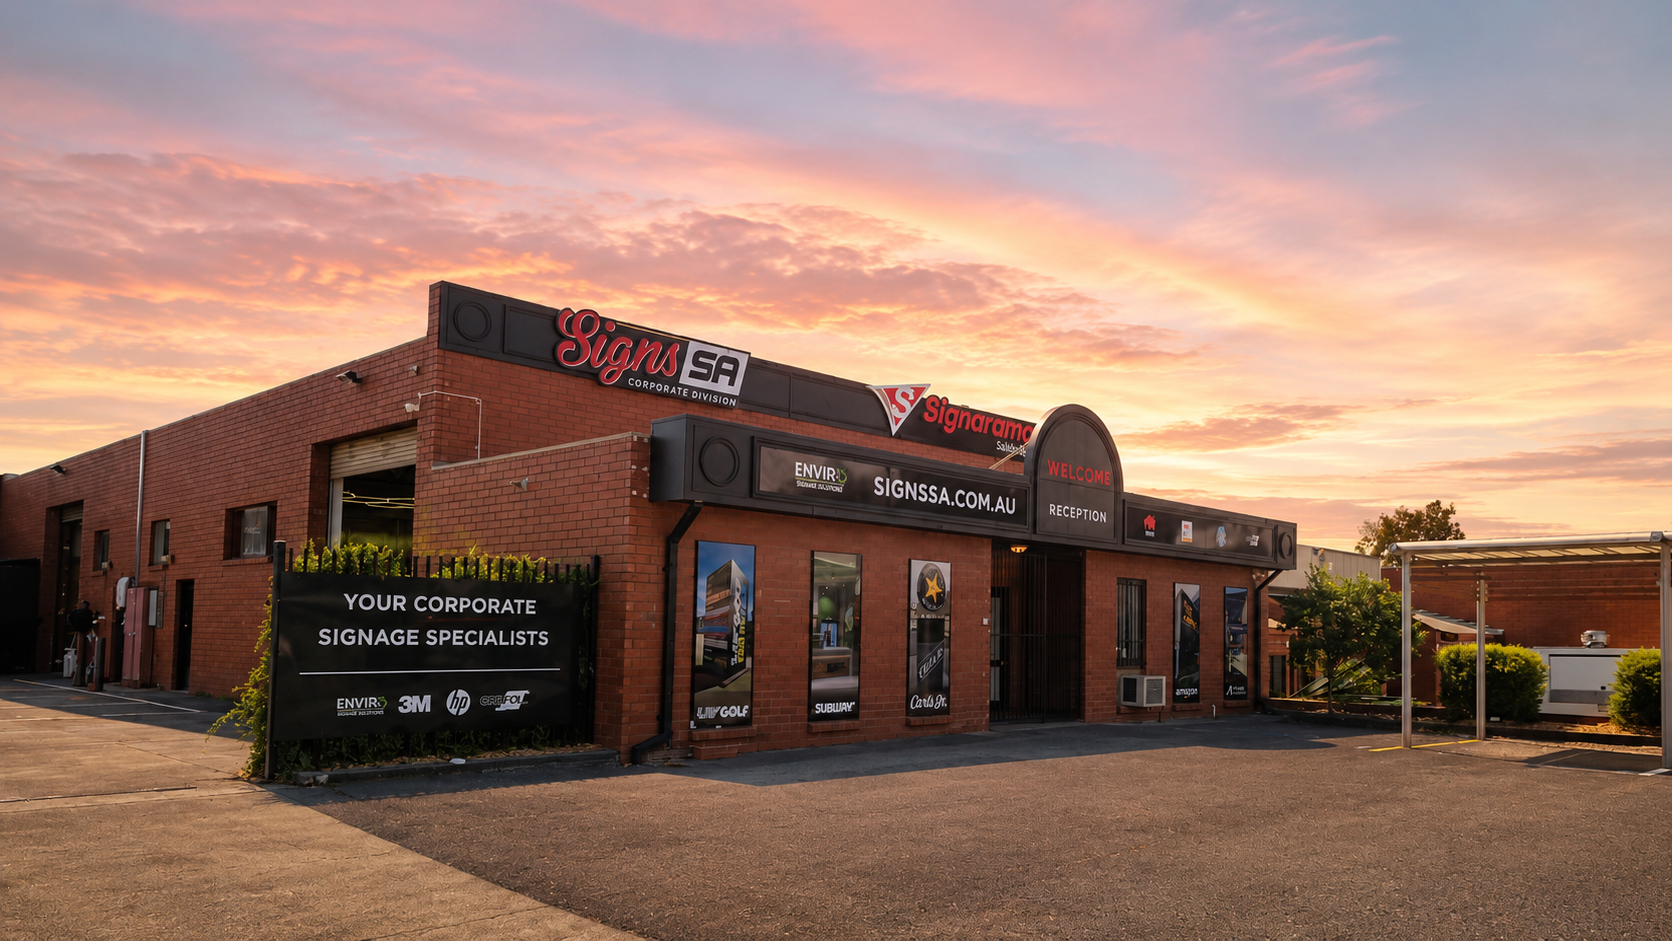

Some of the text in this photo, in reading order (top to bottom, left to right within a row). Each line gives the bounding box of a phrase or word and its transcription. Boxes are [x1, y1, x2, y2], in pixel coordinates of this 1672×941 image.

[556, 308, 741, 387] Signs SA
[628, 377, 737, 407] CORPORATE DIVISION
[1047, 459, 1111, 486] WELCOME
[873, 475, 1017, 515] SIGNSSA.COM.AU
[1049, 503, 1107, 523] RECEPTION
[343, 593, 537, 615] YOUR CORPORATE
[318, 628, 550, 647] SIGNAGE SPECIALISTS
[398, 694, 432, 714] 3M
[448, 689, 470, 715] hp
[720, 705, 749, 718] GOLF
